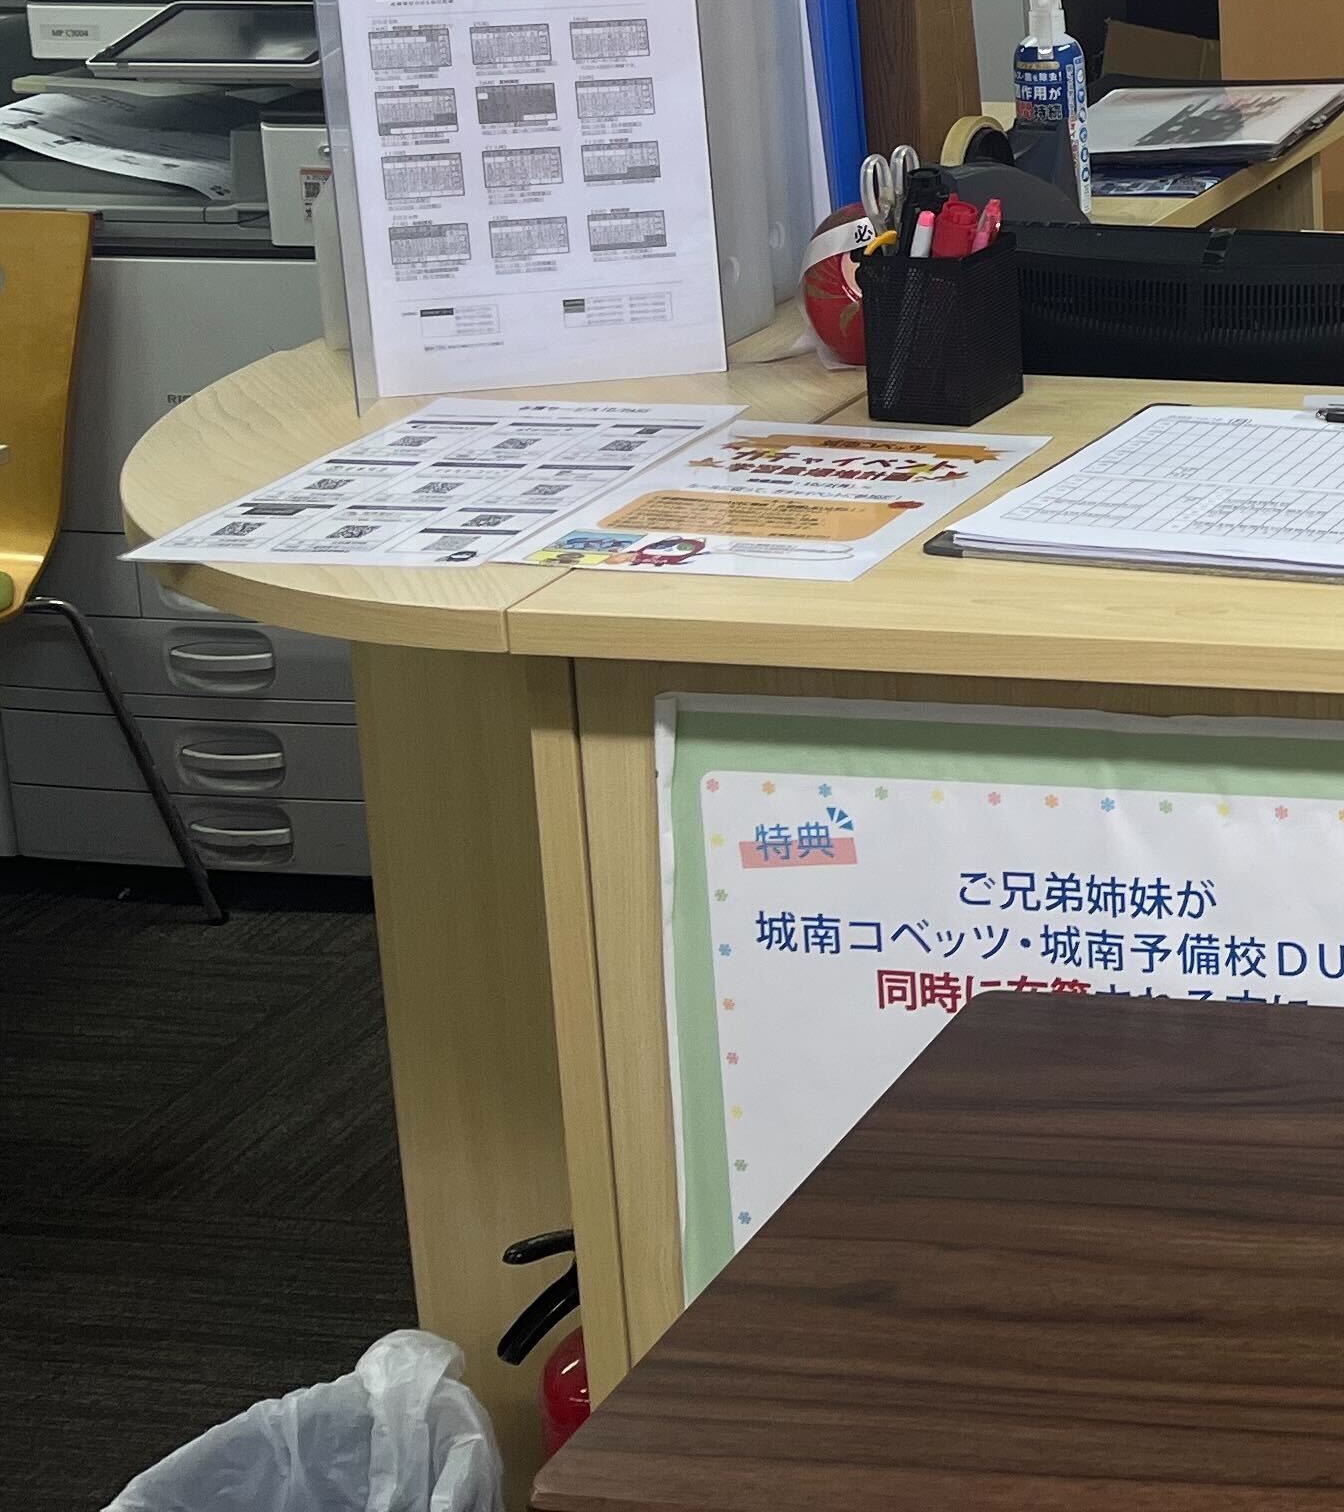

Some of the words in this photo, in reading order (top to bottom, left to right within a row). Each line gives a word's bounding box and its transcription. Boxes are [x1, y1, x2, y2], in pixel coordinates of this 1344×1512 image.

[754, 822, 836, 861] 特典
[957, 869, 1218, 920] ご兄弟姉妹が
